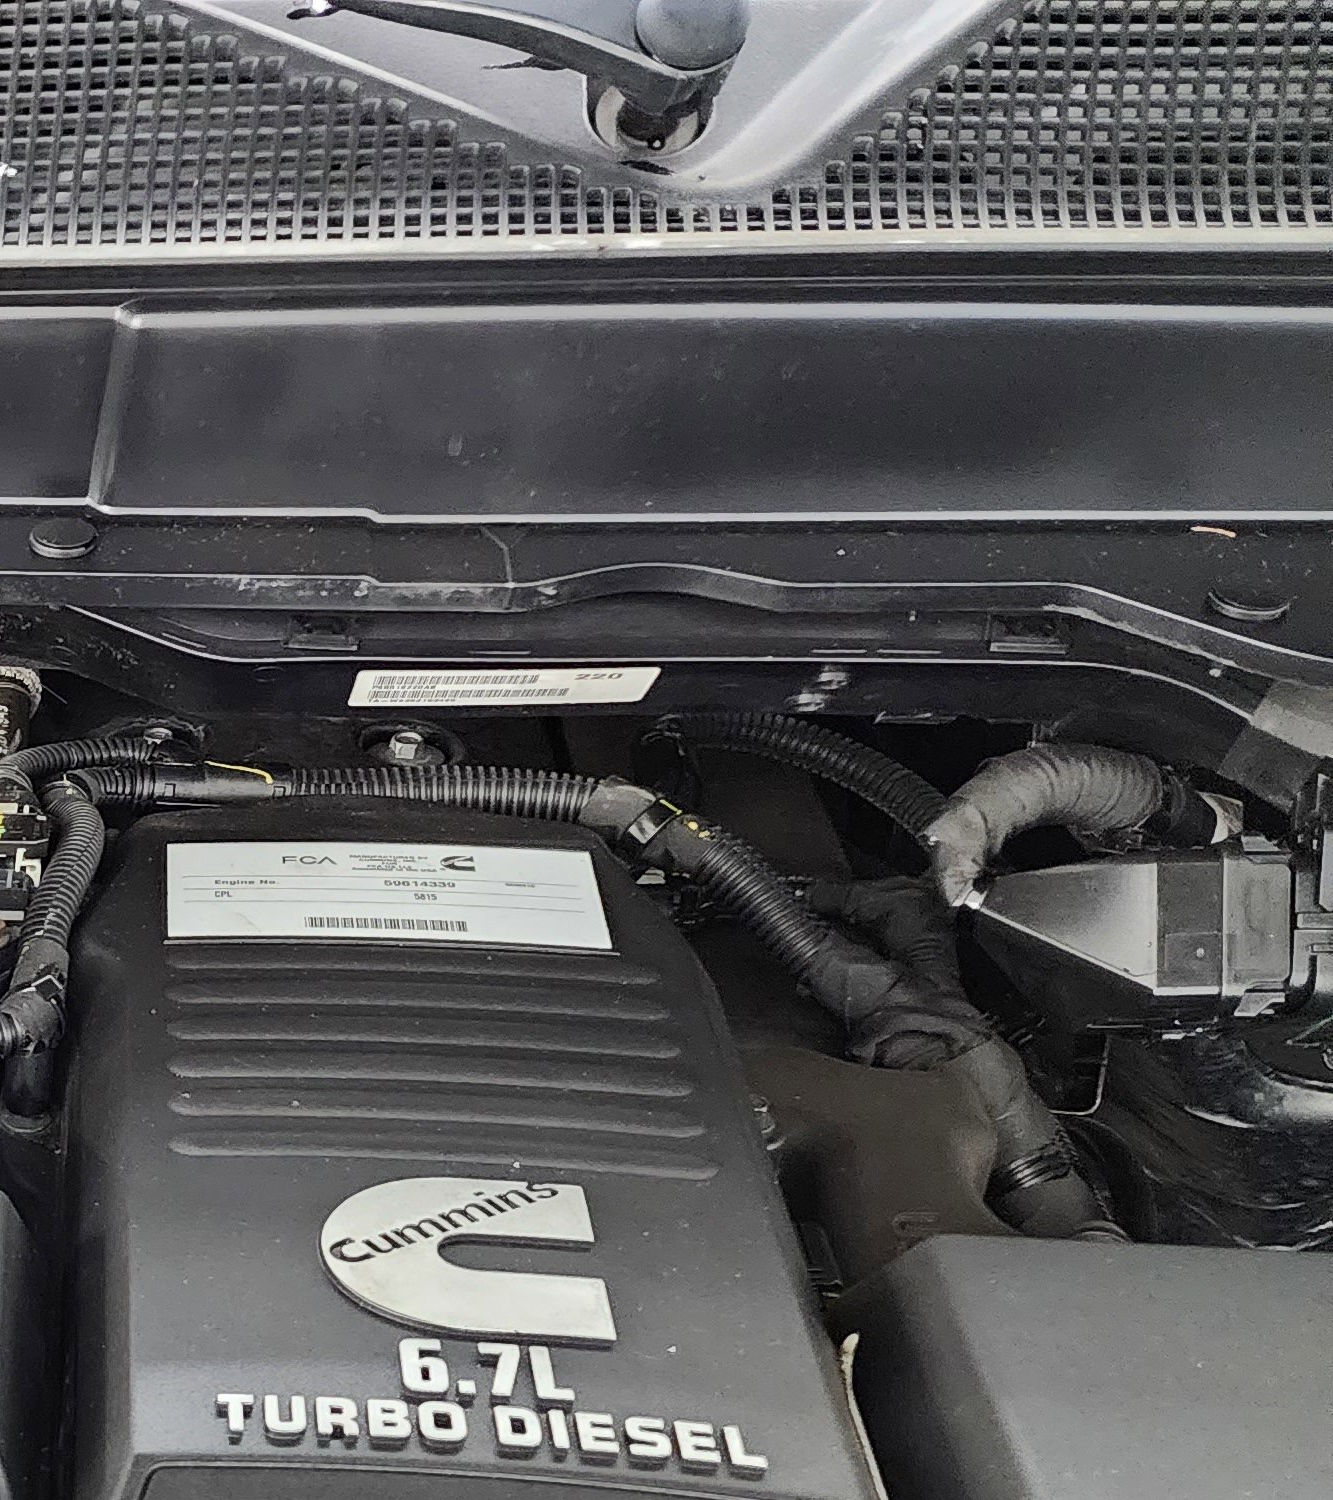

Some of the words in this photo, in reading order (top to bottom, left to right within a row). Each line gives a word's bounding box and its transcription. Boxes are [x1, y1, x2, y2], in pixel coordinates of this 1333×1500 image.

[575, 672, 624, 681] 220
[281, 855, 338, 866] FCA
[214, 879, 255, 887] Engine
[214, 890, 232, 898] CPL
[330, 1185, 559, 1262] Cummins
[399, 1338, 575, 1402] 6.7L
[217, 1394, 468, 1443] TURBO
[492, 1404, 769, 1470] DIESEL
